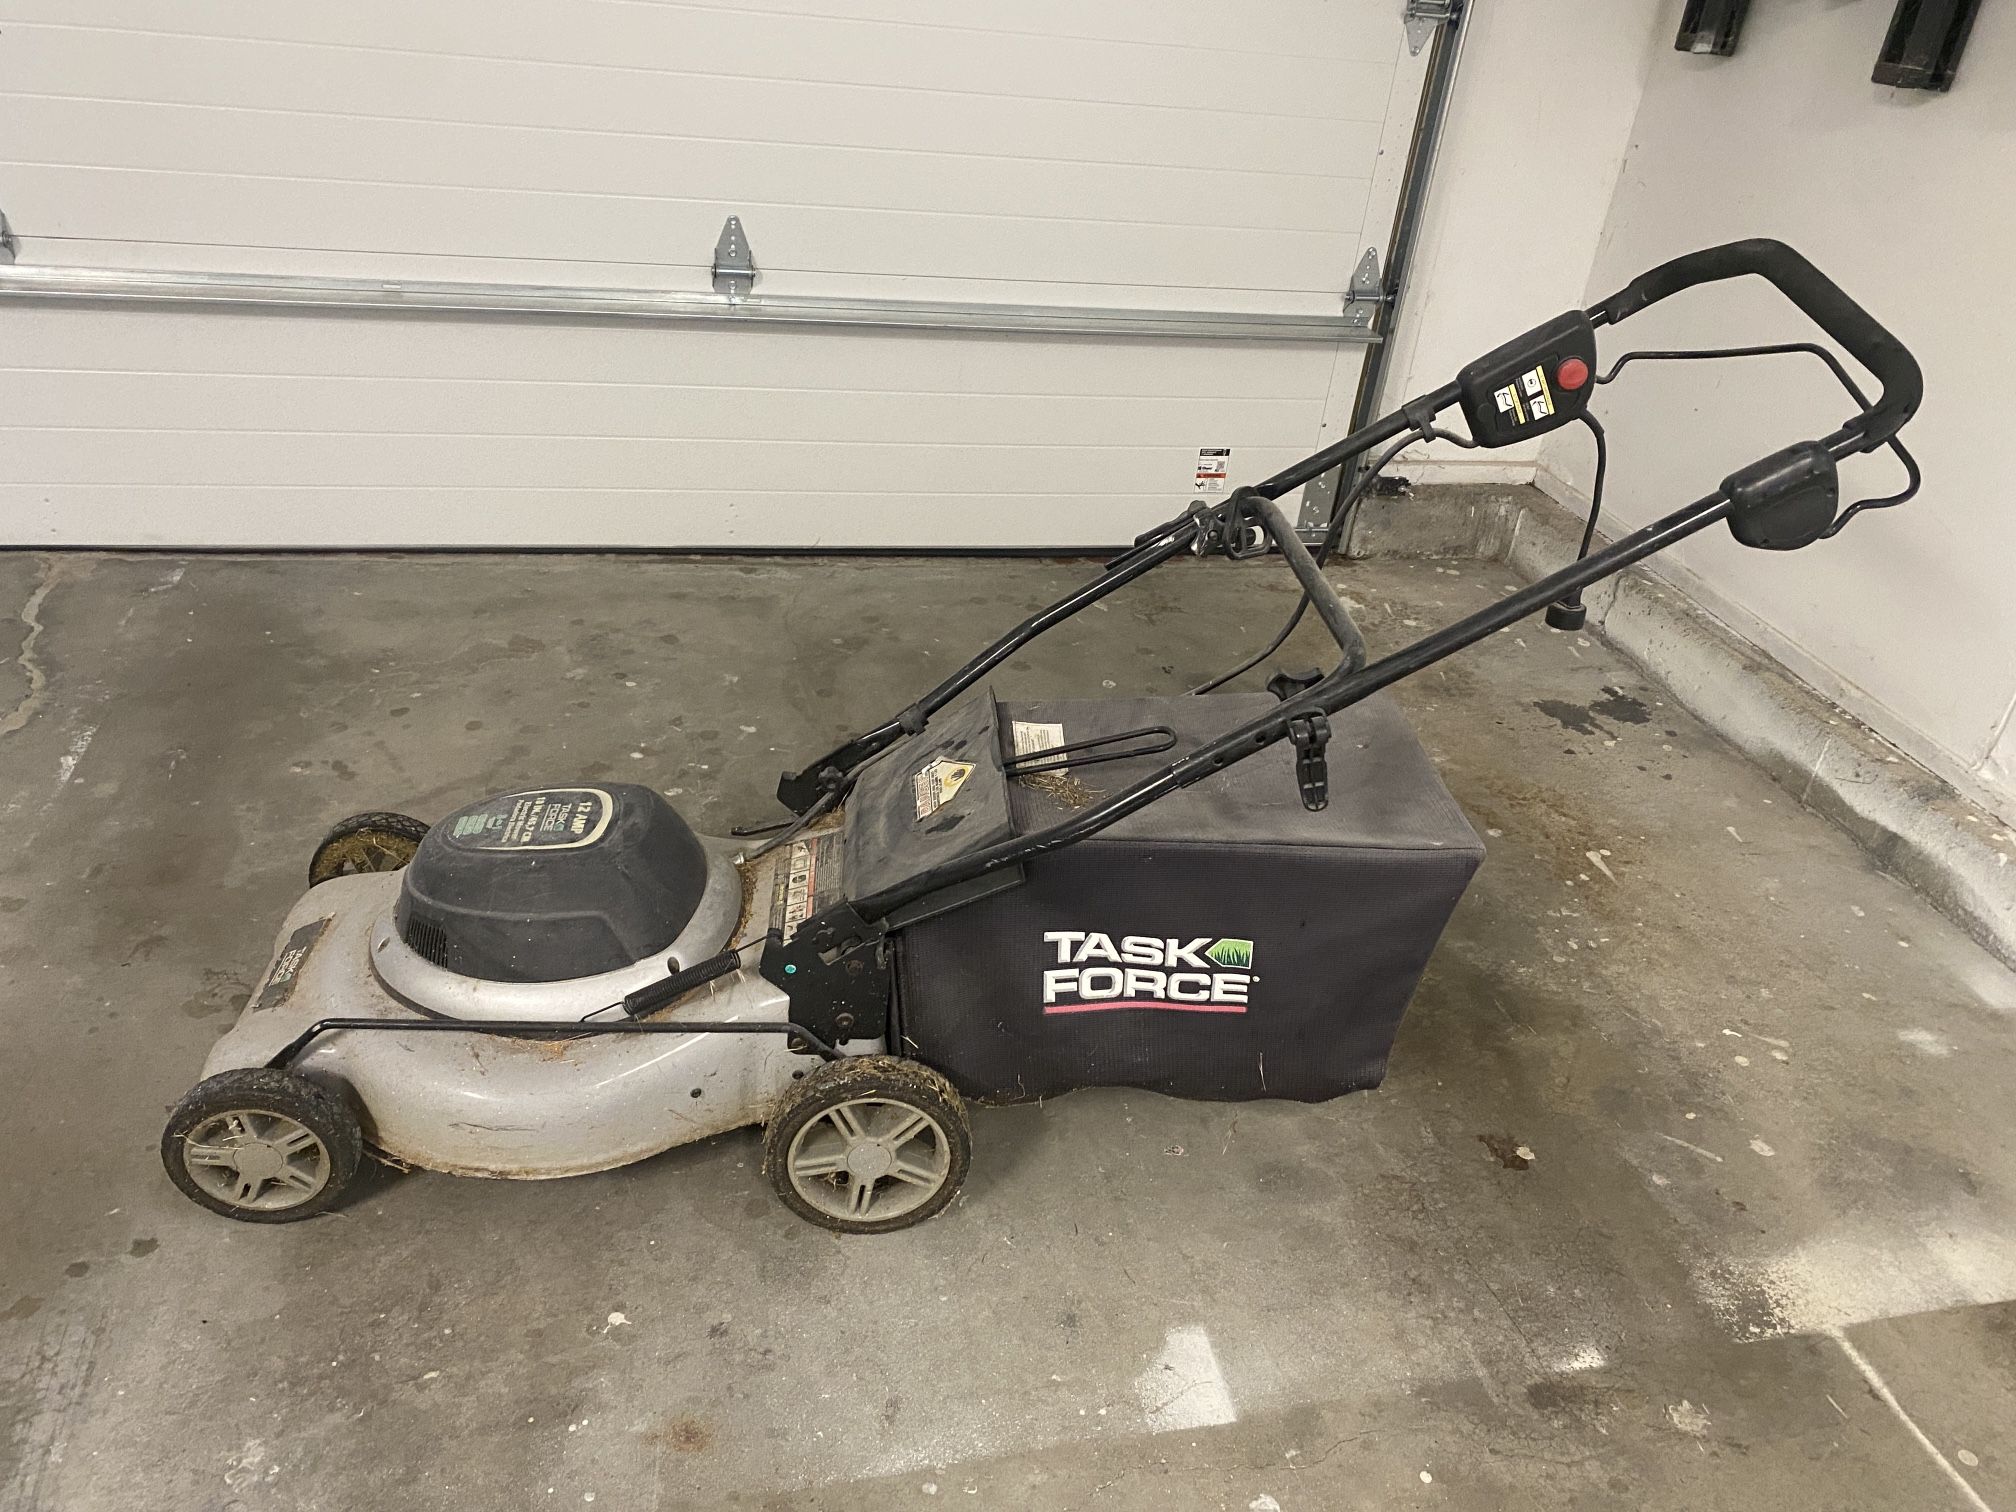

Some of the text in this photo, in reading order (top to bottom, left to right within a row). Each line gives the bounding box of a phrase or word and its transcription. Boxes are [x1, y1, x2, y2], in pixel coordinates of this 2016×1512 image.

[543, 803, 561, 832] FORCE
[557, 803, 572, 824] TASK
[571, 801, 593, 834] 12 AMP
[1043, 931, 1213, 968] TASK
[1043, 967, 1251, 1003] FORCE
